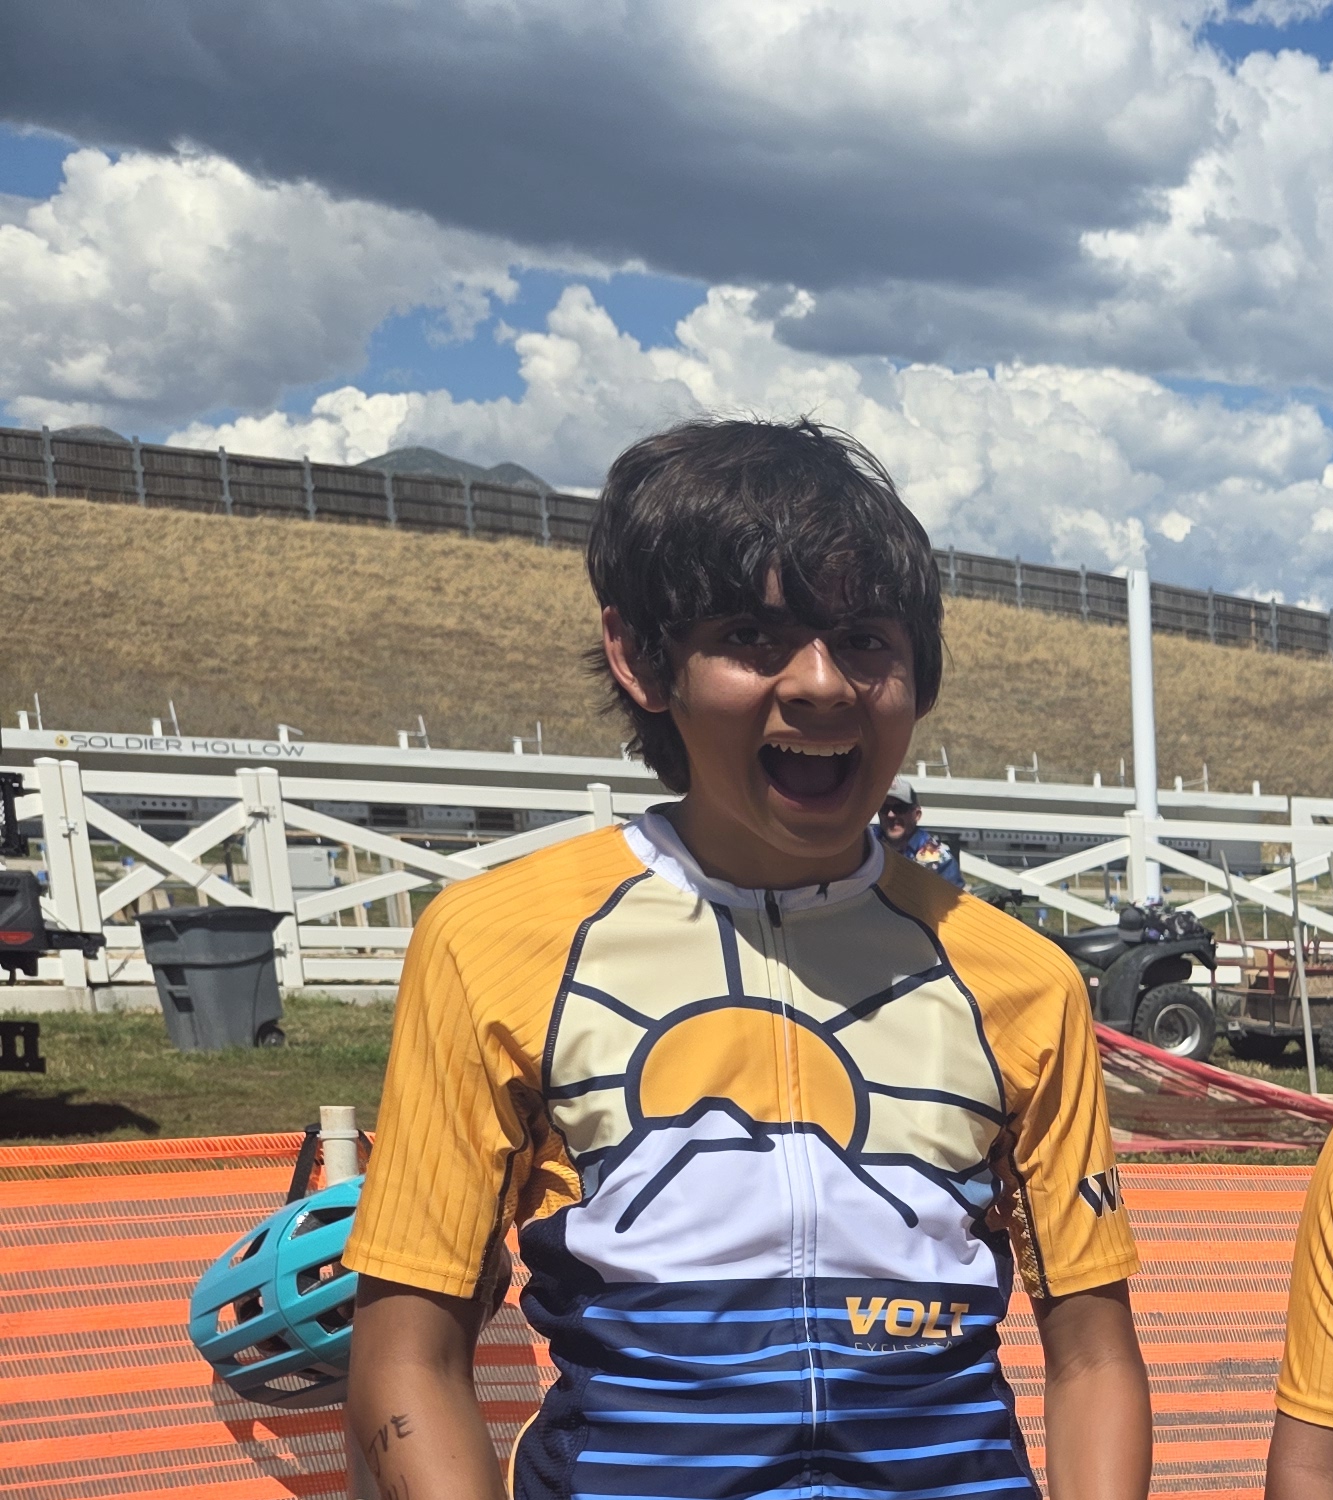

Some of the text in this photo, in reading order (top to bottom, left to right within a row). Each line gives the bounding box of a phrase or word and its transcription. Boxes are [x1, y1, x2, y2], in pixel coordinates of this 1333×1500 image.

[70, 735, 304, 756] SOLDIER HOLLOW
[846, 1297, 970, 1339] VOLT
